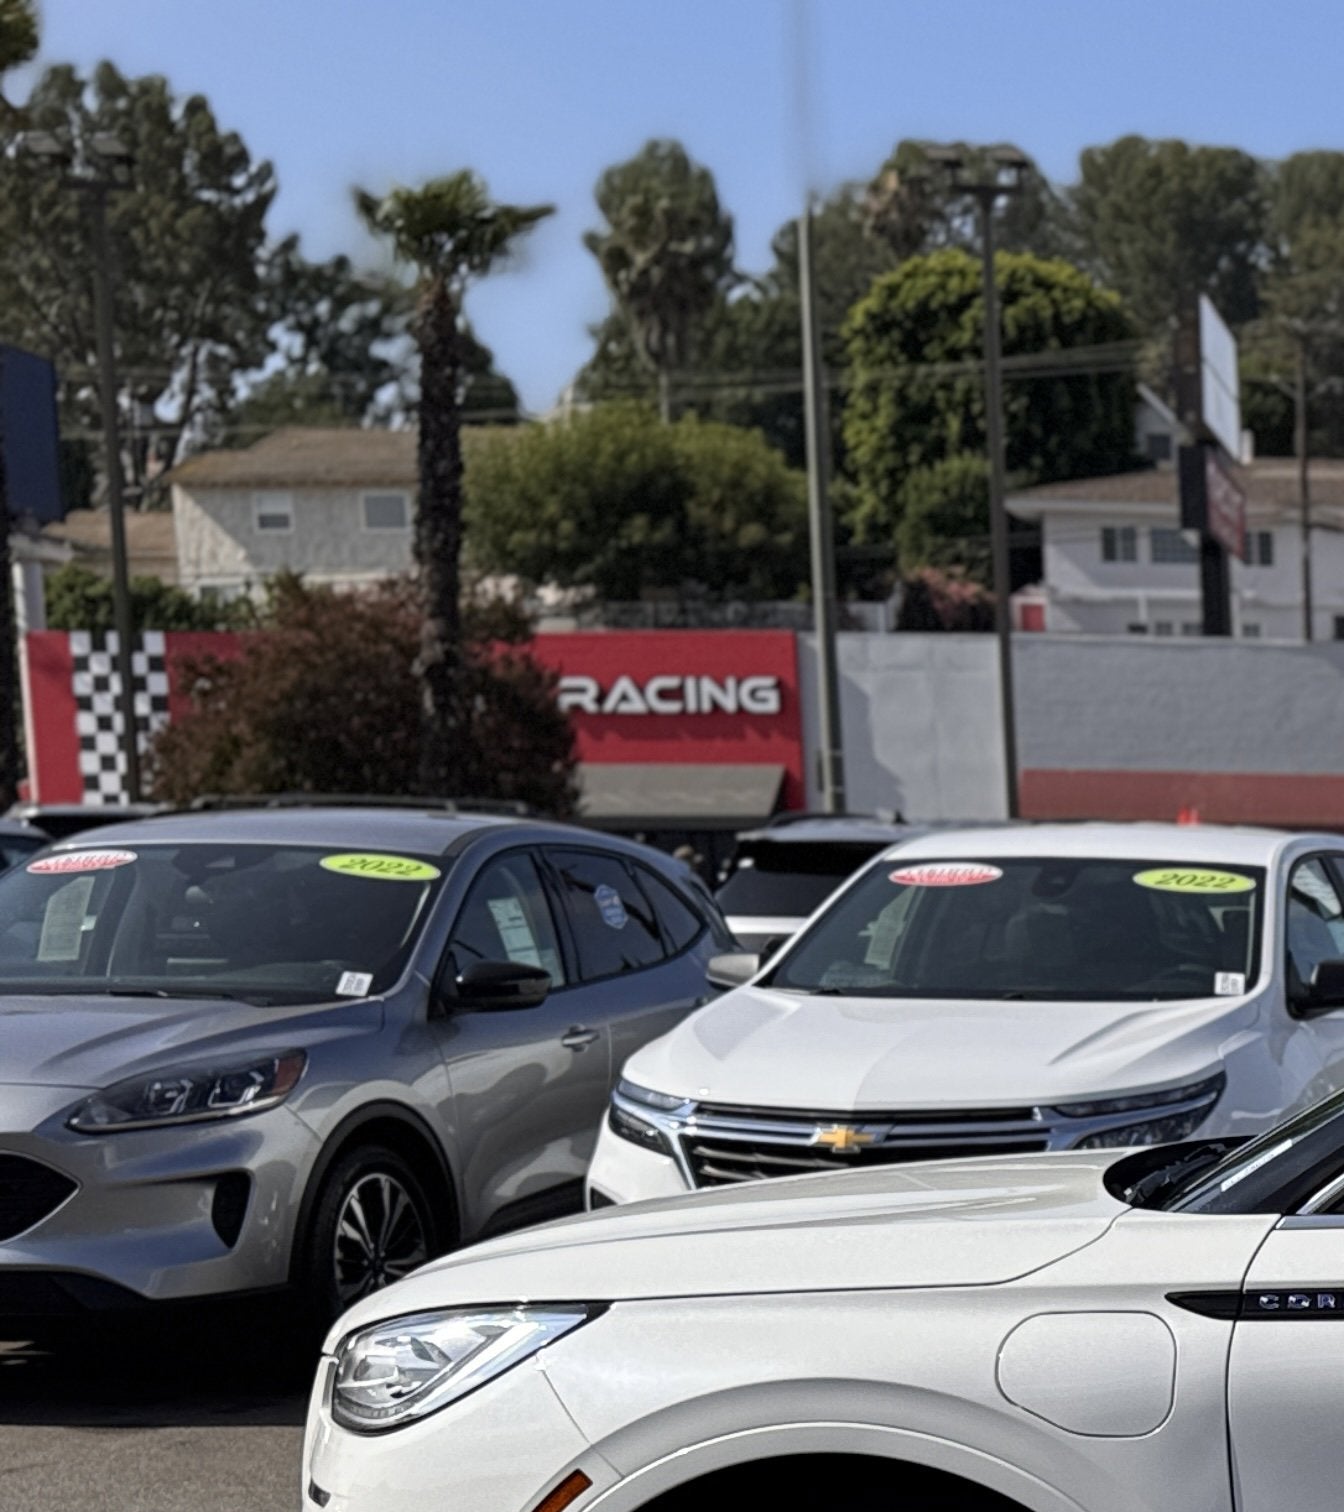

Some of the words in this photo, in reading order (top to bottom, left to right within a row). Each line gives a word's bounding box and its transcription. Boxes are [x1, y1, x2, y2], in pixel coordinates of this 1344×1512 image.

[557, 674, 782, 715] RACING
[339, 858, 423, 877] 2022
[1154, 873, 1236, 888] 2022
